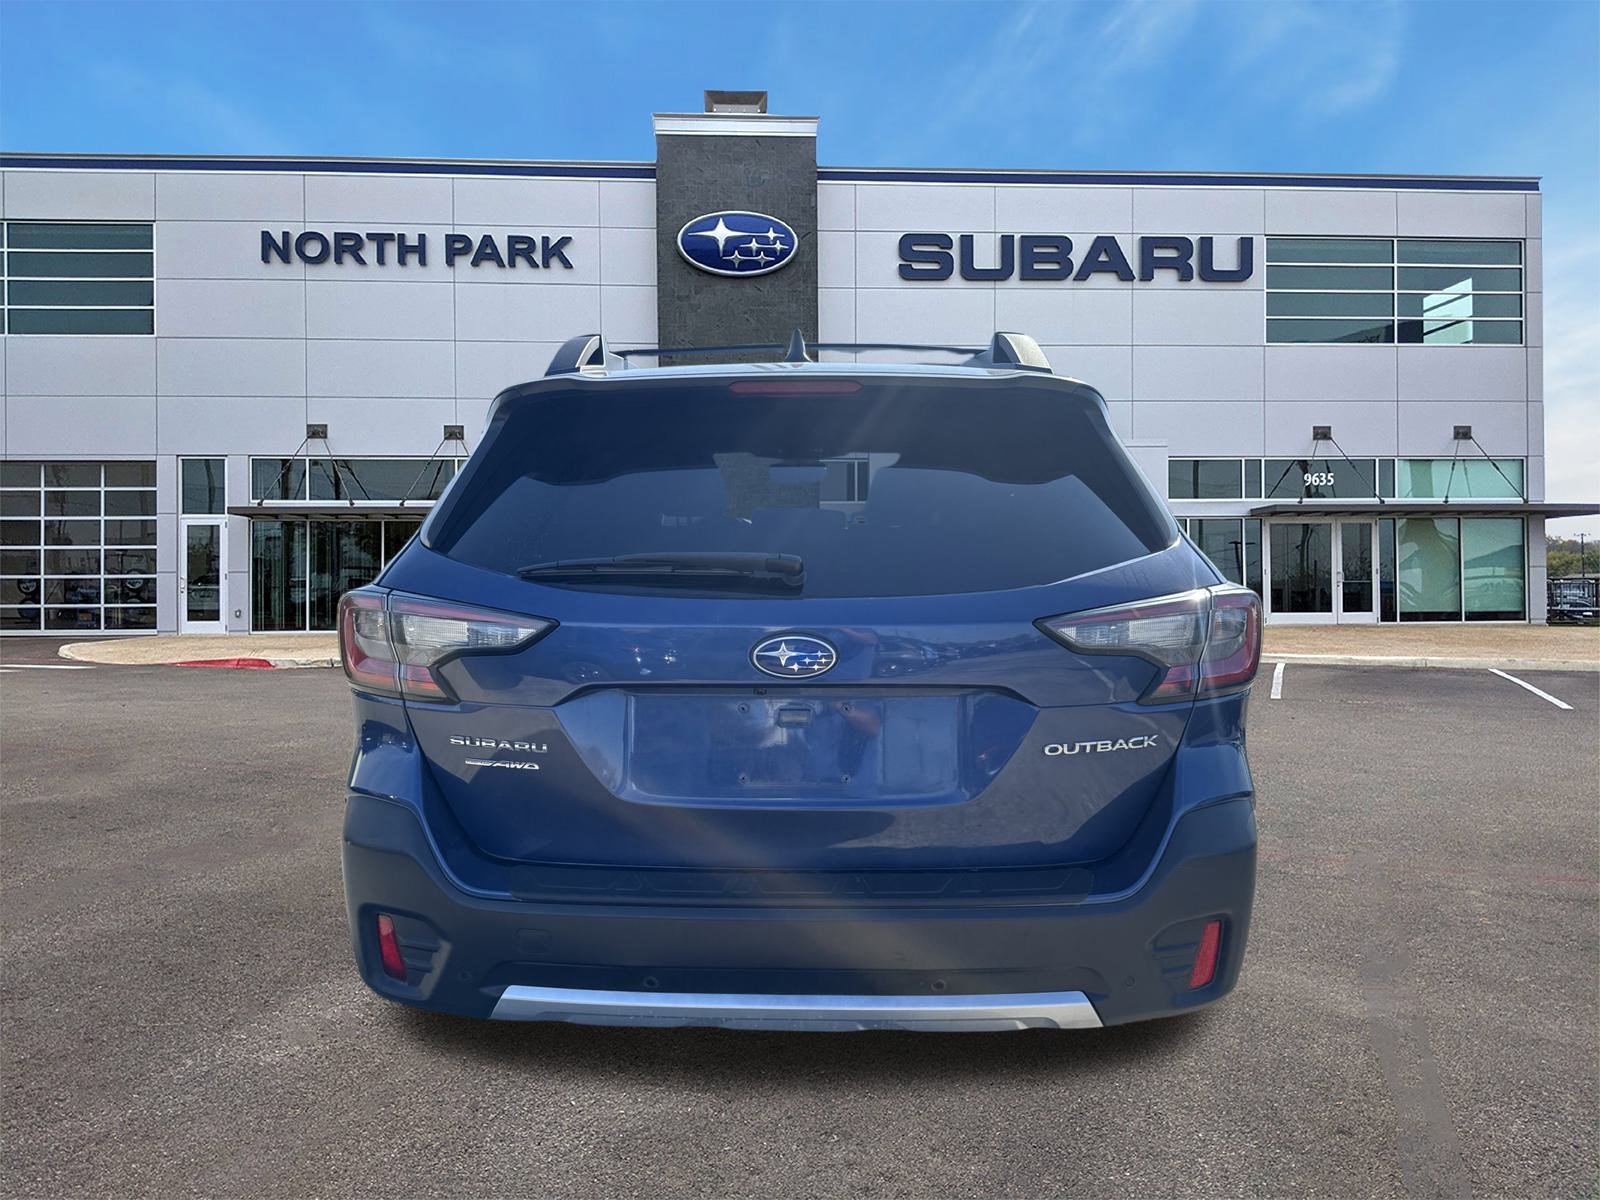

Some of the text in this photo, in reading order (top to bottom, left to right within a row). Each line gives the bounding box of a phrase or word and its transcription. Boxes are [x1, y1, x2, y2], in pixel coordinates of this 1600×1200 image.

[260, 229, 574, 270] NORTH PARK
[898, 233, 1254, 283] SUBARU
[1304, 472, 1334, 486] 9635
[448, 735, 548, 753] SUBARU
[1044, 734, 1159, 756] OUTBACK
